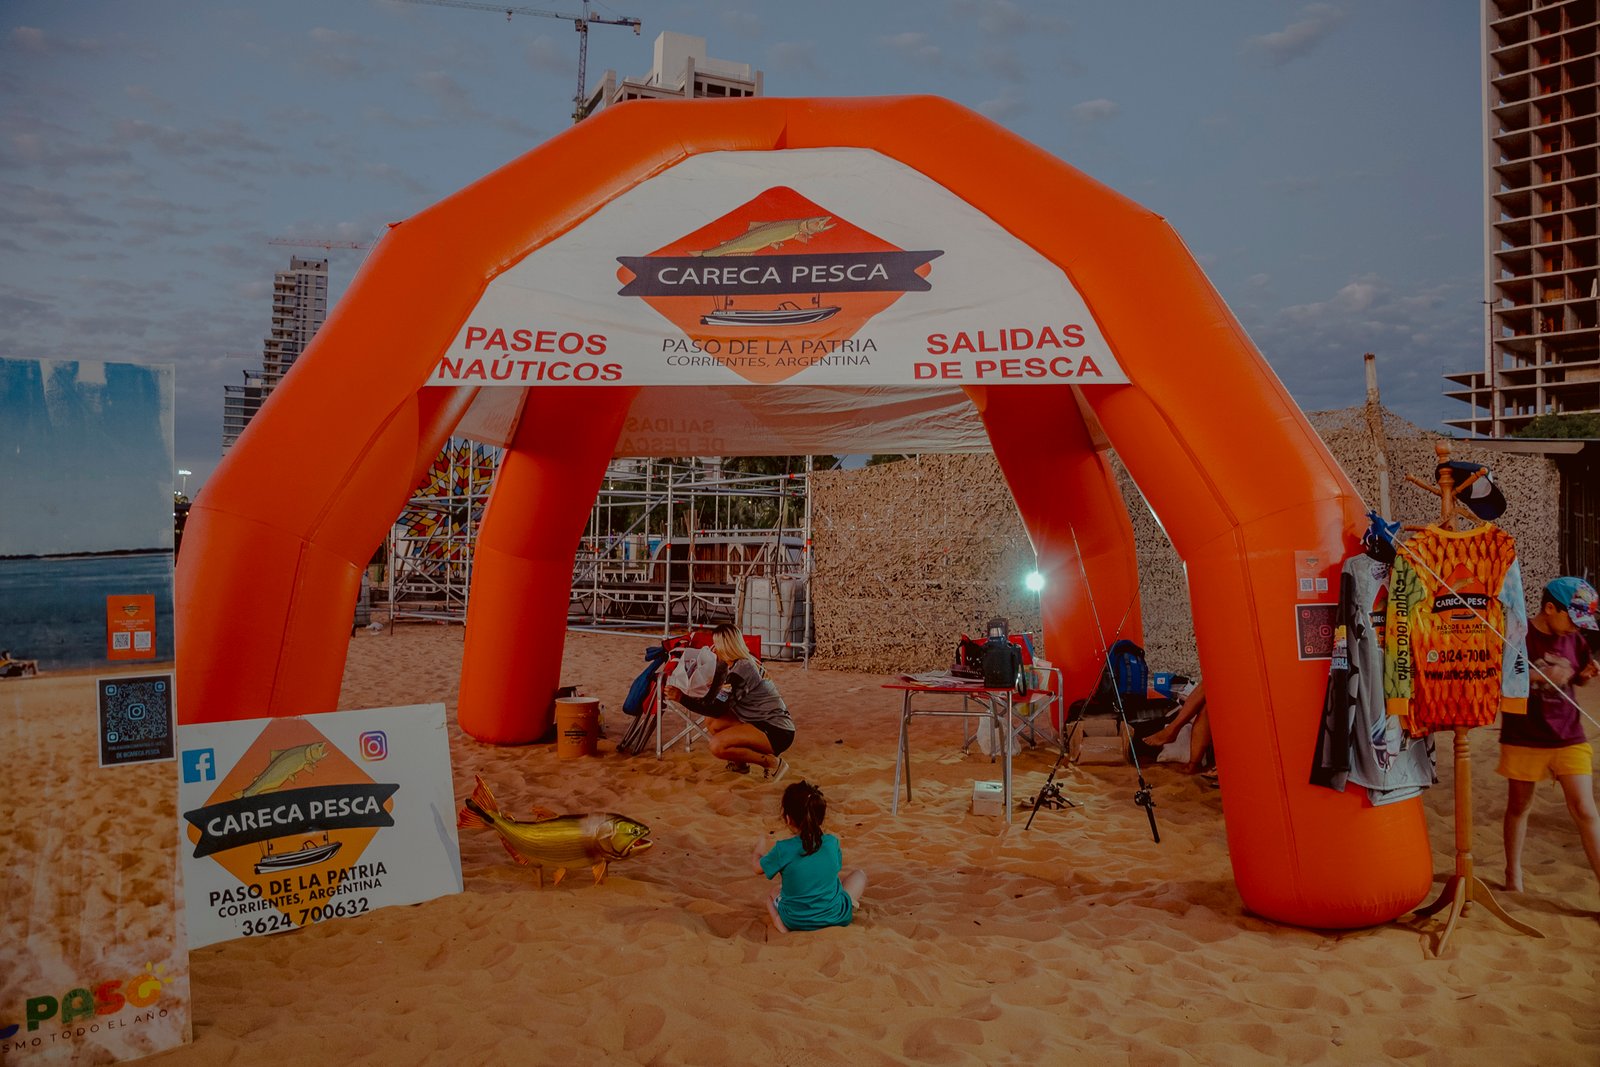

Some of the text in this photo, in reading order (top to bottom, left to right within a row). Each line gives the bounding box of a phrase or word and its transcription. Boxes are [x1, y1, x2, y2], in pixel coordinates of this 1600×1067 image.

[657, 263, 889, 286] CARECA PESCA
[464, 326, 608, 356] PASEOS
[662, 337, 878, 355] PASO DE LA PATRIA
[926, 324, 1086, 355] SALIDAS
[438, 353, 623, 381] NAÚTICOS
[666, 355, 871, 368] CORRIENTES, ARGENTINA
[914, 355, 1104, 380] DE PESCA
[206, 795, 381, 837] CARECA PESCA
[208, 861, 388, 907] PASO DE LA PATRIA
[218, 877, 383, 918] CORRIENTES, ARGENTINA
[242, 897, 370, 937] 3624 700632
[26, 973, 162, 1032] PASO
[50, 1024, 100, 1044] TODO
[108, 1018, 127, 1030] EL
[134, 1009, 168, 1024] AÑO
